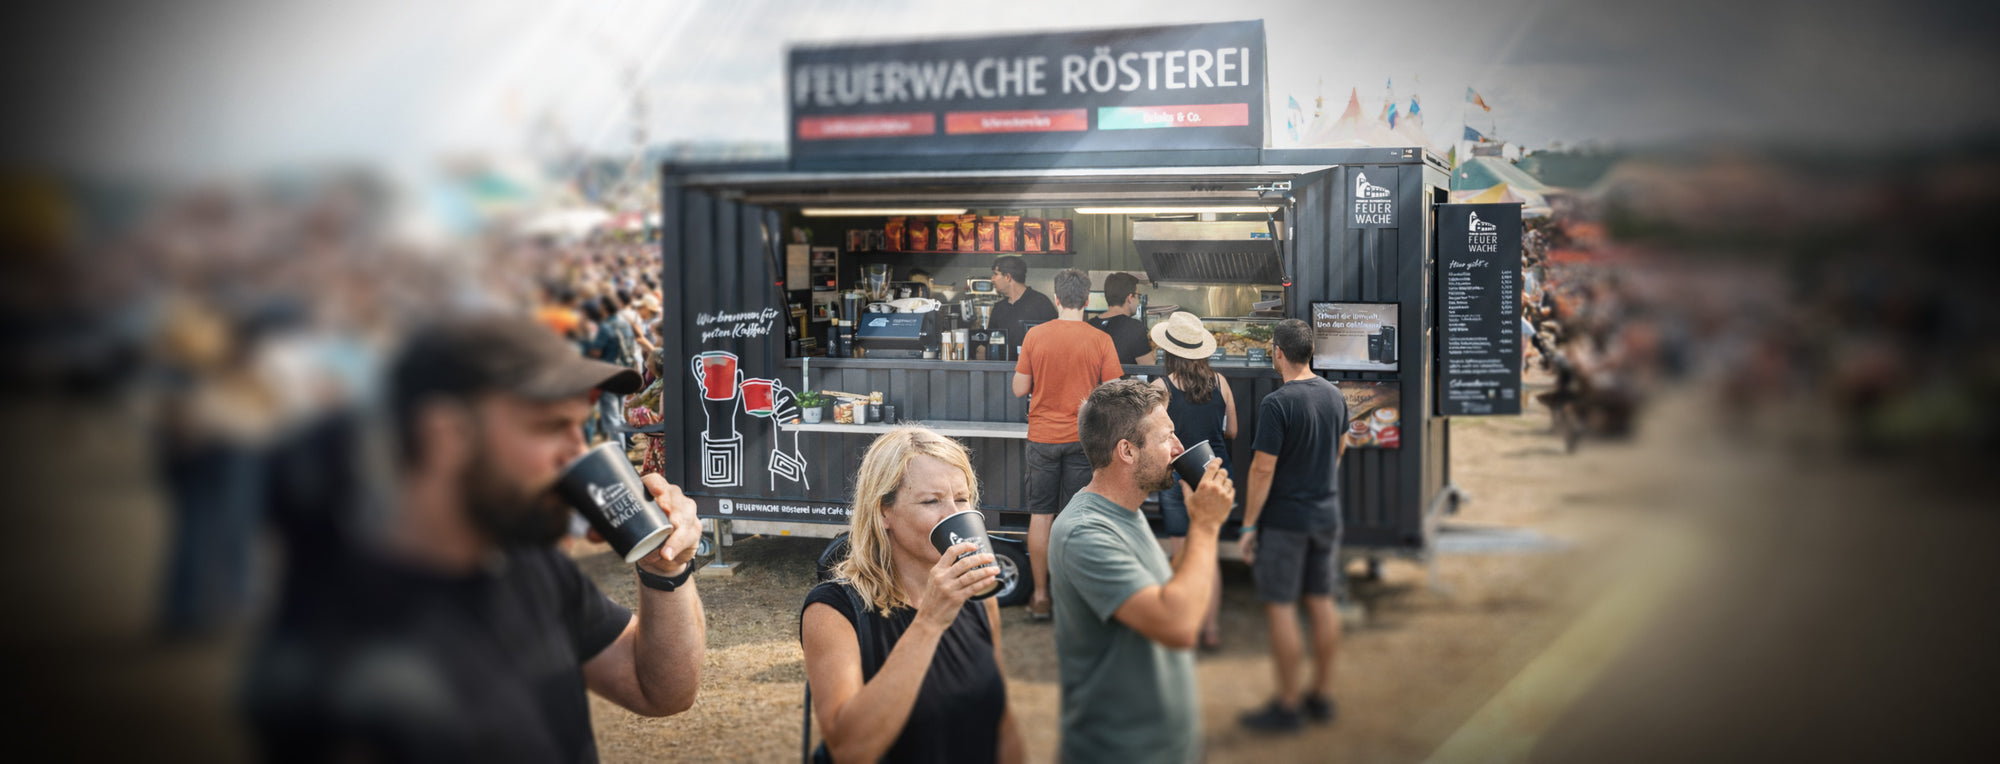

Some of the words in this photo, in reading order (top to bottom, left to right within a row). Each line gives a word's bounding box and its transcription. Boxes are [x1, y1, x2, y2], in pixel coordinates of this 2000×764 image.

[795, 56, 1047, 107] FEUERWACHE
[1062, 46, 1250, 94] RÖSTEREI
[1187, 111, 1202, 122] Co.
[1355, 203, 1391, 213] FEUER
[1355, 214, 1391, 224] WACHE
[1468, 235, 1498, 244] FEUER
[1468, 245, 1498, 253] WACHE
[603, 493, 638, 520] FEUER
[735, 503, 780, 512] FEUERWACHE
[781, 505, 810, 514] Rösterei
[812, 507, 826, 515] und
[609, 502, 645, 528] WACHE
